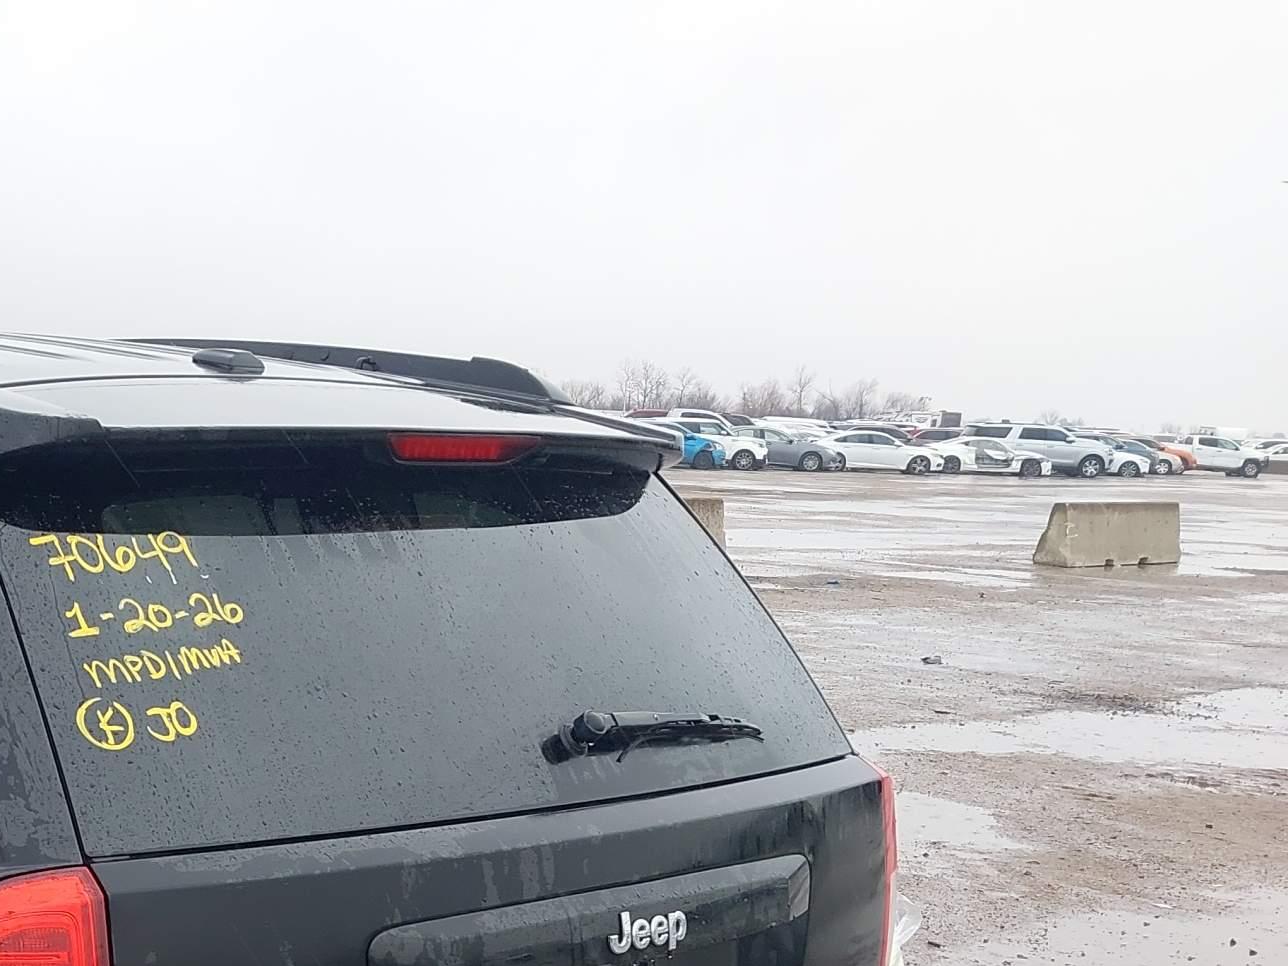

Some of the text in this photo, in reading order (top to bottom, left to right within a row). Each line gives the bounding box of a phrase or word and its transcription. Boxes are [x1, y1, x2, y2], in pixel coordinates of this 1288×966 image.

[29, 531, 198, 584] 70649
[65, 593, 244, 638] 1-20-26
[608, 910, 687, 954] Jeep
